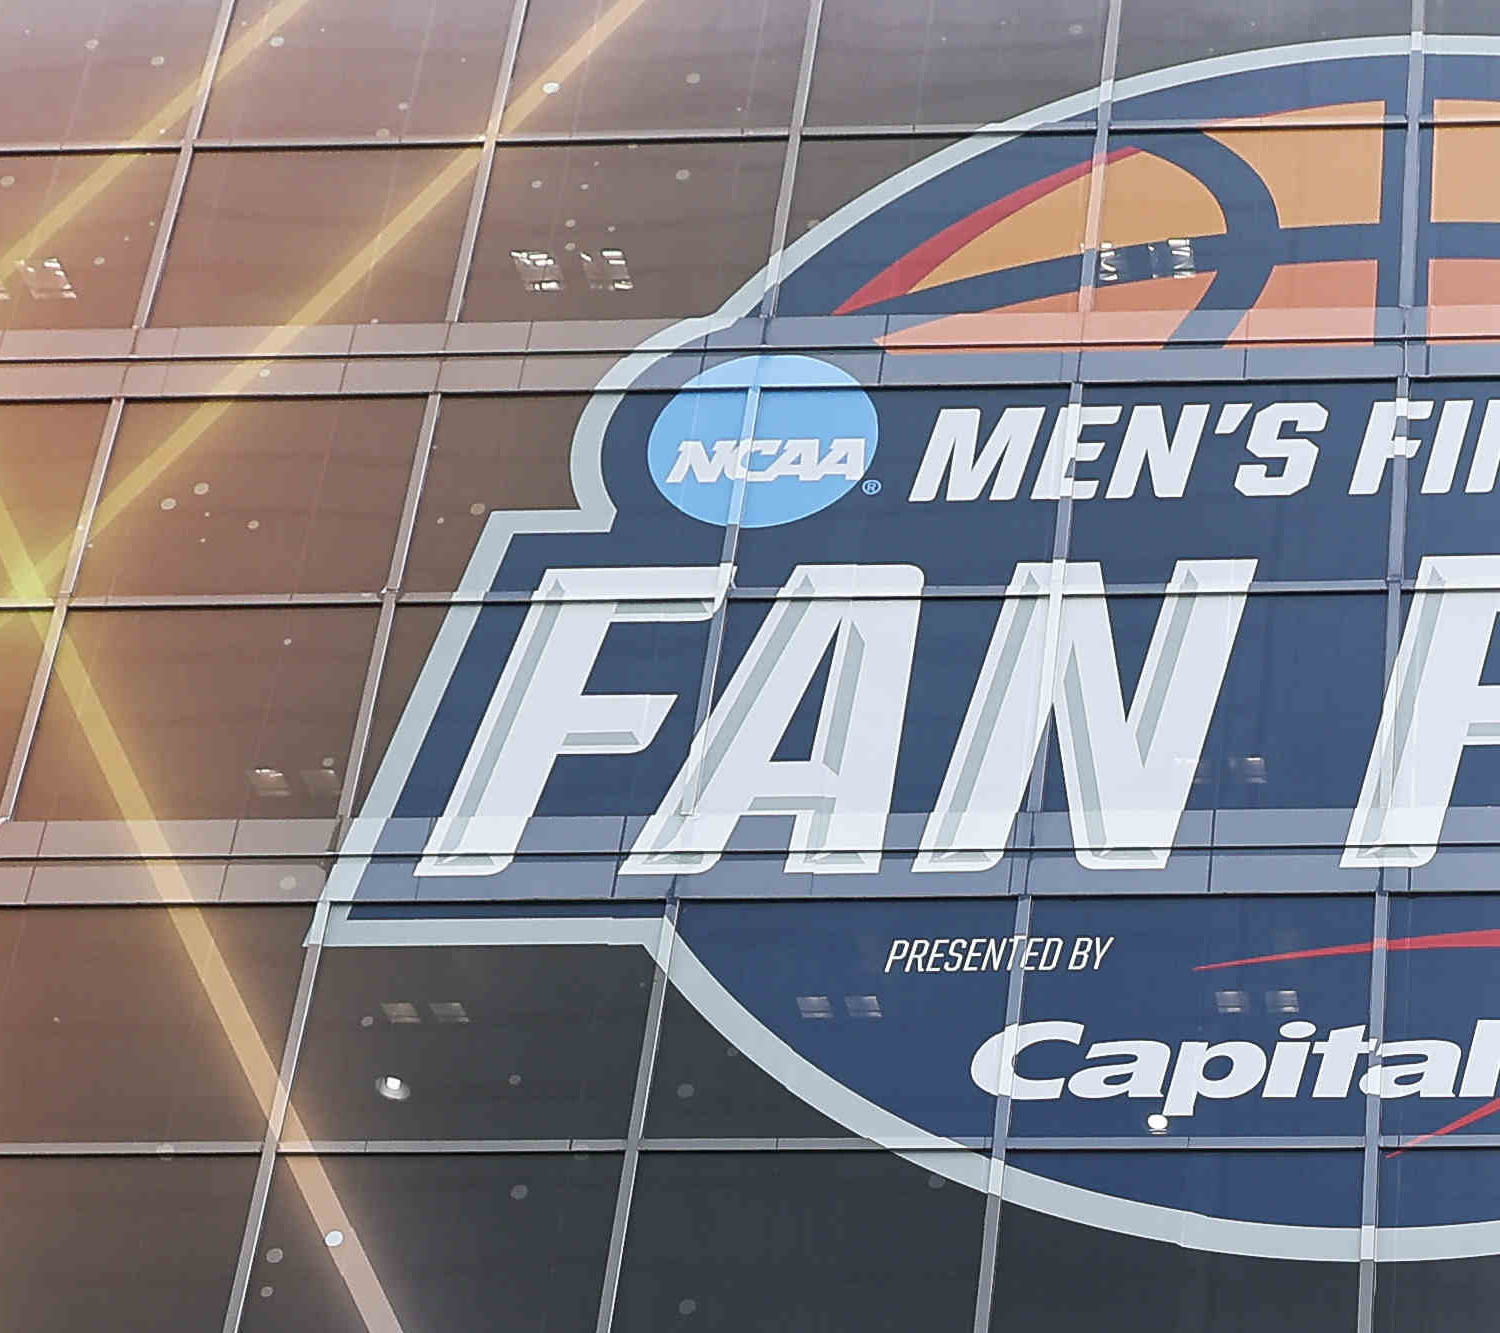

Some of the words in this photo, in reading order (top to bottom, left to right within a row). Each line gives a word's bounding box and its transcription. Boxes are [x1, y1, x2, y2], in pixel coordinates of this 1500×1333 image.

[666, 437, 868, 483] NCAA
[907, 402, 1328, 502] MEN'S
[414, 558, 1258, 877] FAN
[884, 936, 1063, 974] PRESENTED
[1069, 936, 1114, 971] BY
